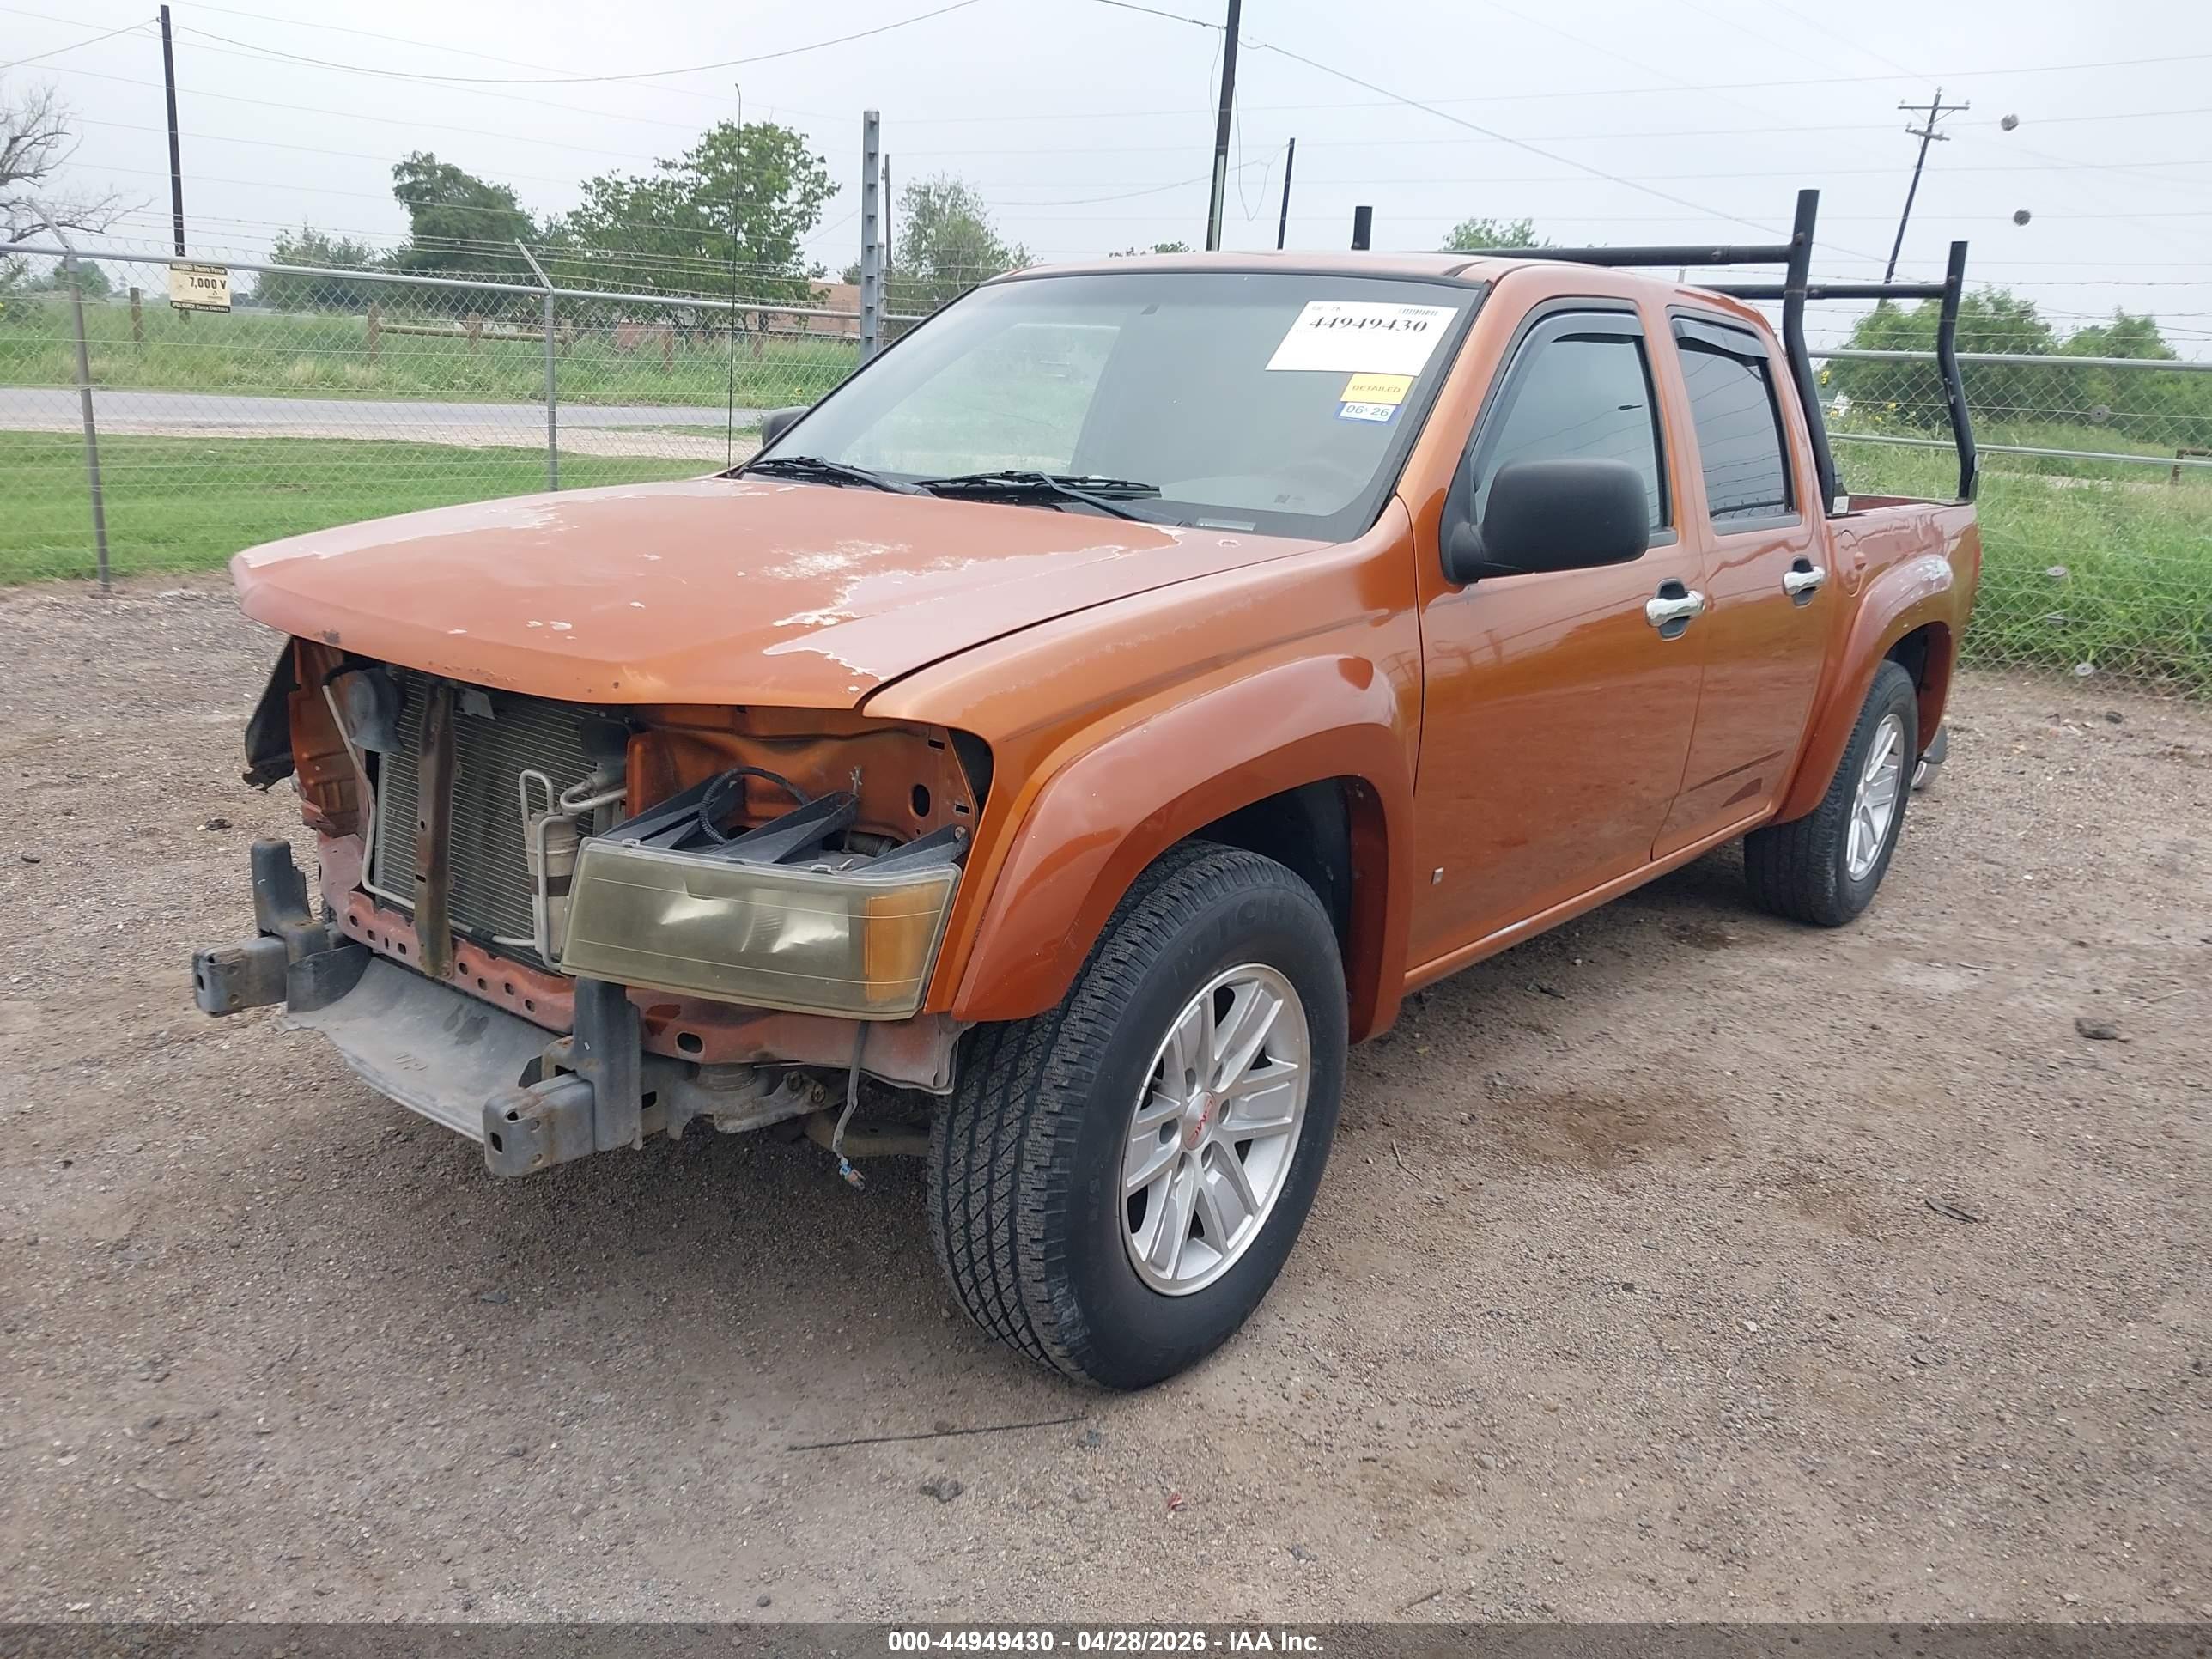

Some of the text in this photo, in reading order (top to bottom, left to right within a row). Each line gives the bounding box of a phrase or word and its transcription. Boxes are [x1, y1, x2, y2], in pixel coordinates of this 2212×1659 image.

[189, 276, 227, 290] 7,000 V
[1309, 316, 1428, 333] 44949430
[1352, 384, 1401, 393] DETAILED
